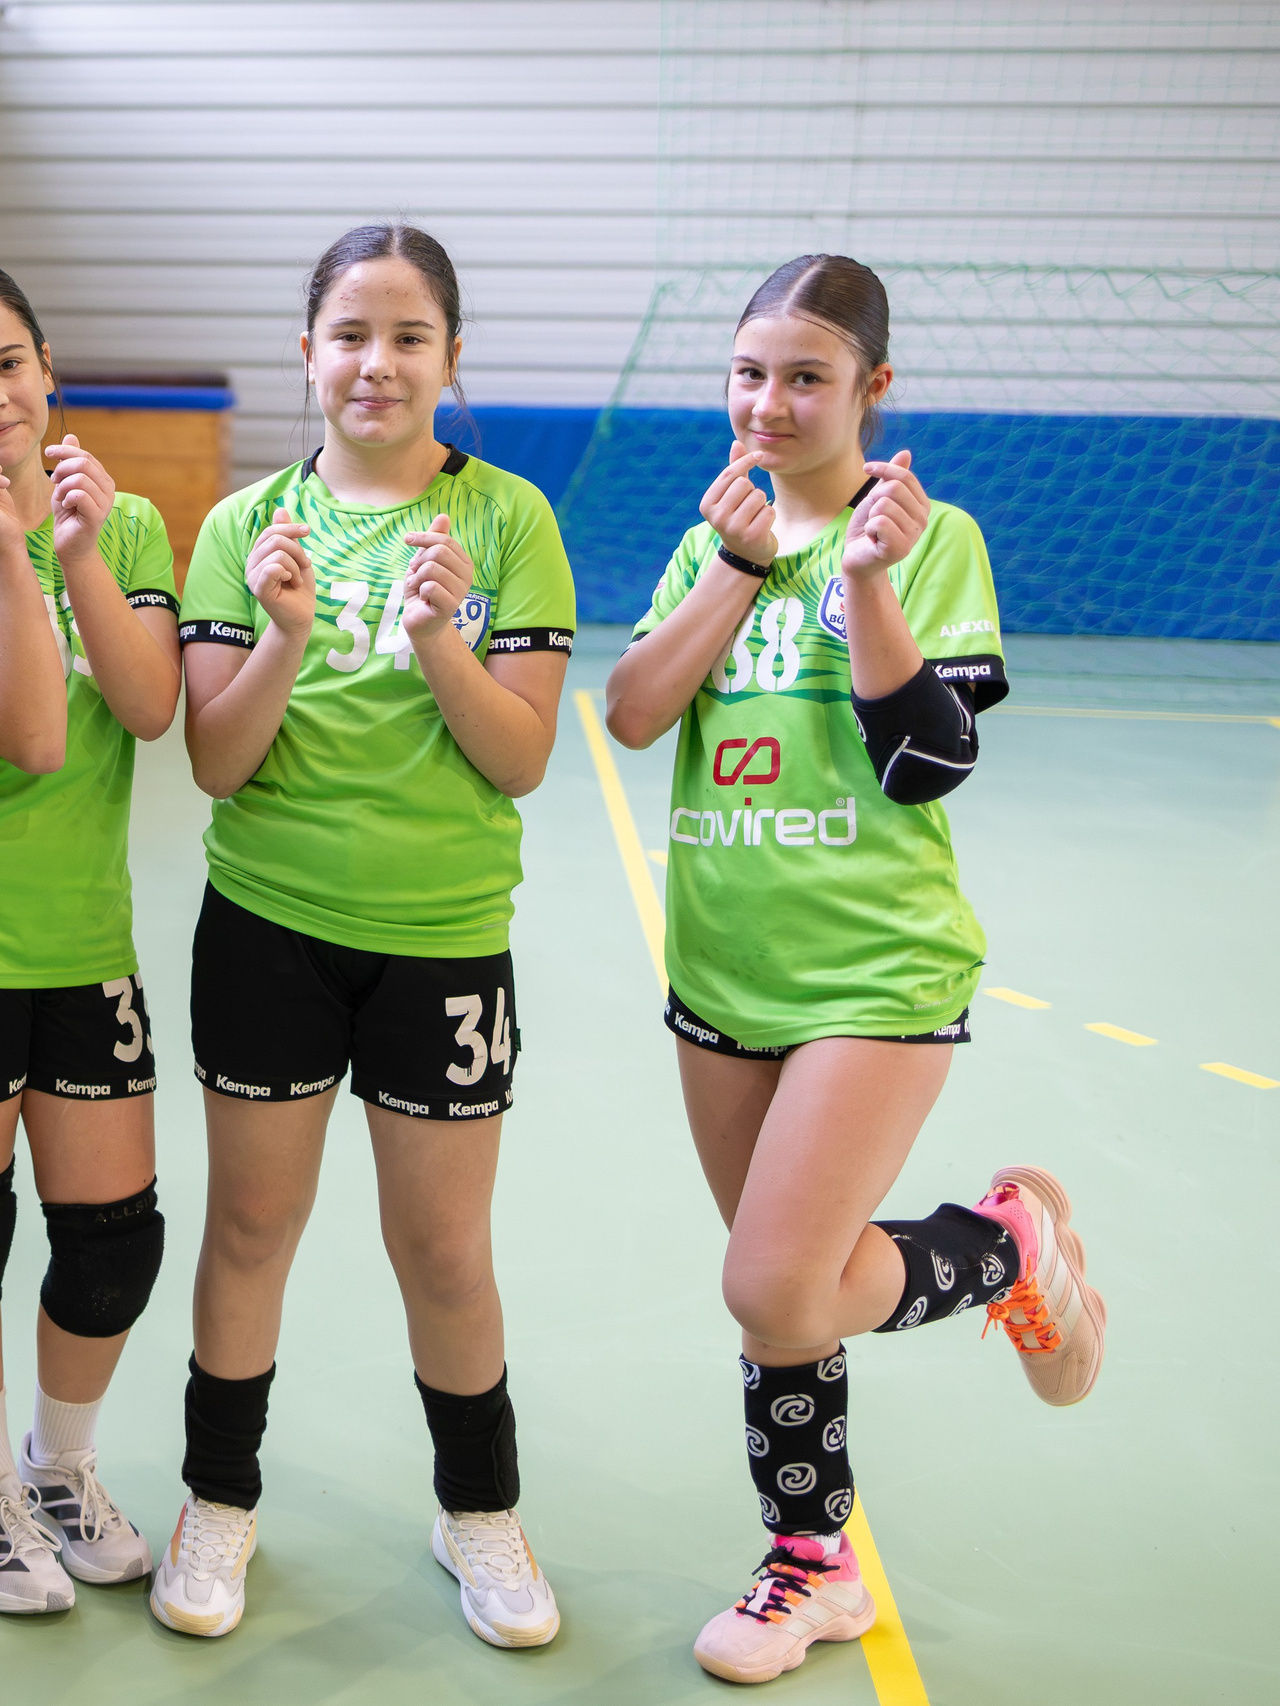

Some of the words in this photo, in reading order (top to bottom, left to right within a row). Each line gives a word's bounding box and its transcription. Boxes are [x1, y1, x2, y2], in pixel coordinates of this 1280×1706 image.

[126, 593, 168, 606] empa
[209, 621, 254, 645] Kemp
[325, 580, 415, 673] 34
[488, 636, 531, 651] empa
[549, 632, 573, 650] Kemp
[932, 664, 991, 680] Kempa
[670, 796, 857, 846] covired
[101, 970, 155, 1063] 3
[674, 1012, 719, 1045] Kempa
[445, 987, 512, 1086] 34
[55, 1078, 111, 1098] Kempa
[128, 1076, 156, 1093] Kemp
[216, 1074, 271, 1098] Kempa
[290, 1075, 335, 1096] Kempa
[378, 1090, 429, 1115] Kempa
[449, 1099, 499, 1117] Kempa
